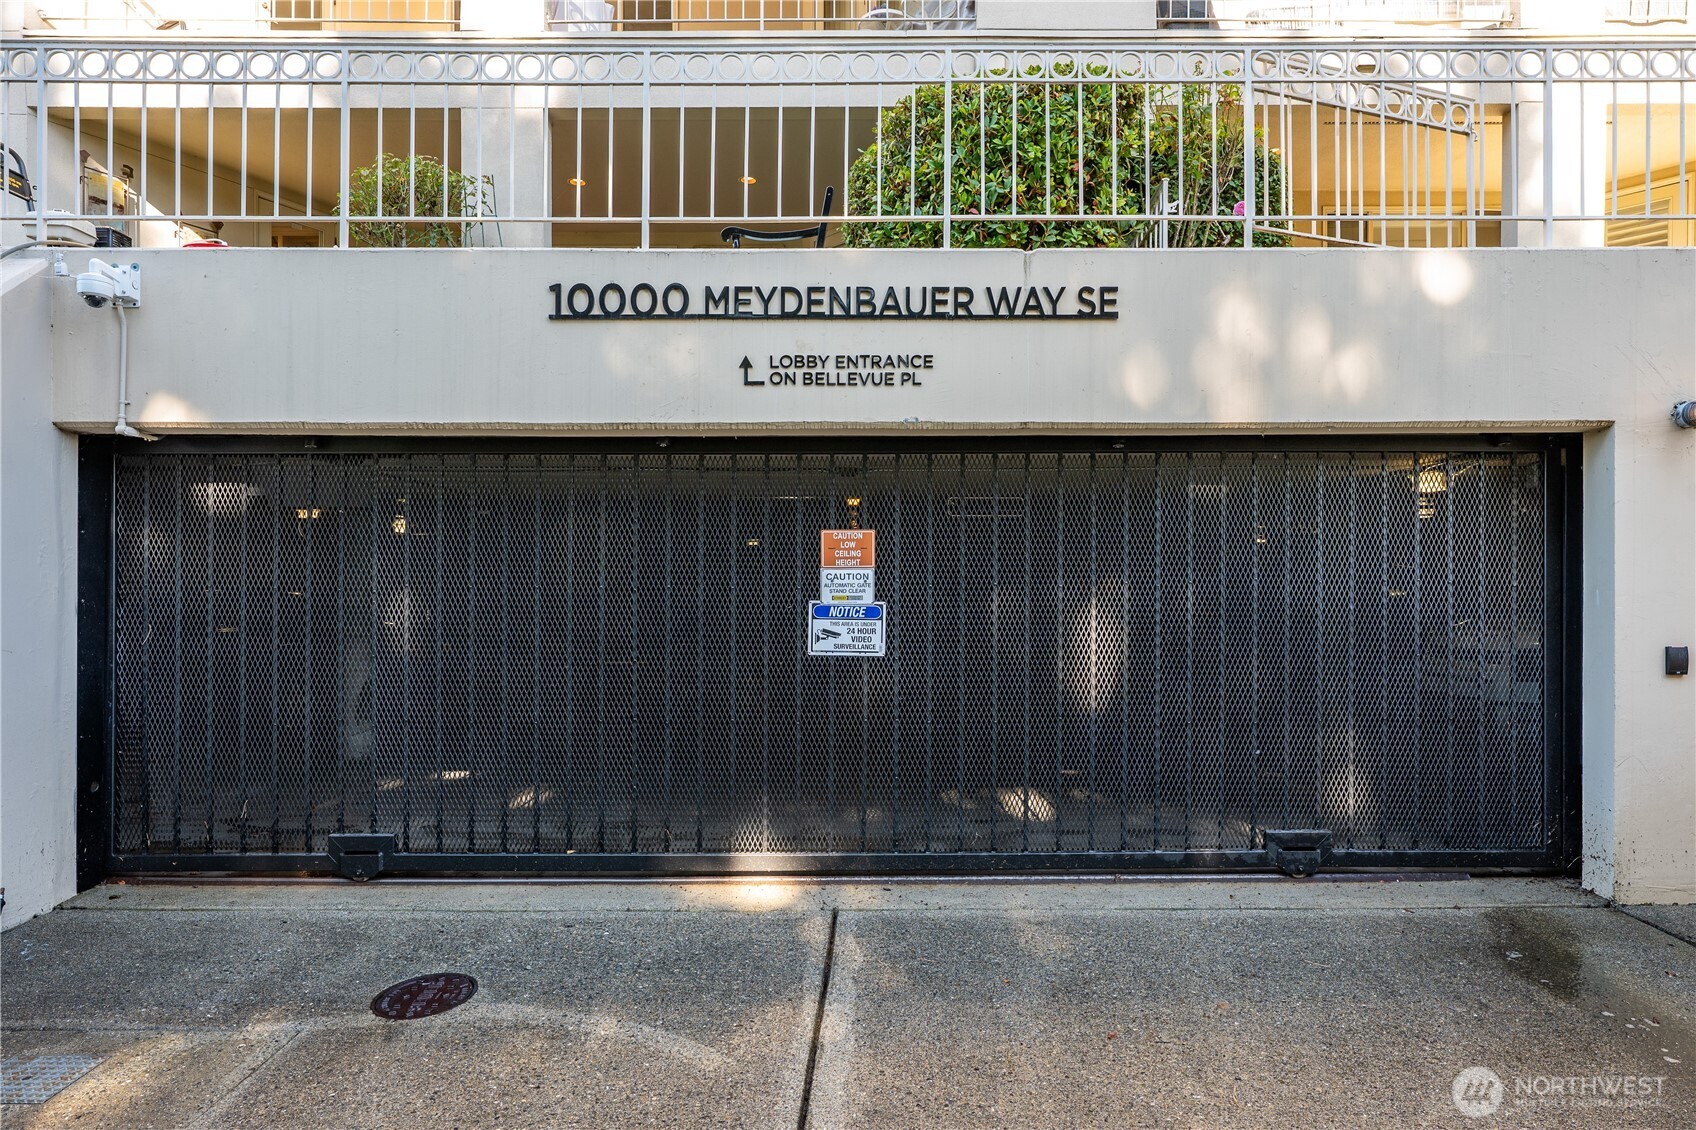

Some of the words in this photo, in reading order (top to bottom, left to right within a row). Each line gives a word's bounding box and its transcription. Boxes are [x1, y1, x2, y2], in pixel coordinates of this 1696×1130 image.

[549, 283, 689, 317] 10000
[704, 286, 974, 317] MEYDENBAUER
[986, 286, 1066, 317] WAY
[1077, 286, 1118, 318] SE
[769, 355, 829, 369] LOBBY
[835, 355, 933, 369] ENTRANCE
[769, 372, 796, 385] ON
[803, 372, 894, 386] BELLEVUE
[901, 372, 921, 386] PL
[829, 606, 866, 617] NOTICE
